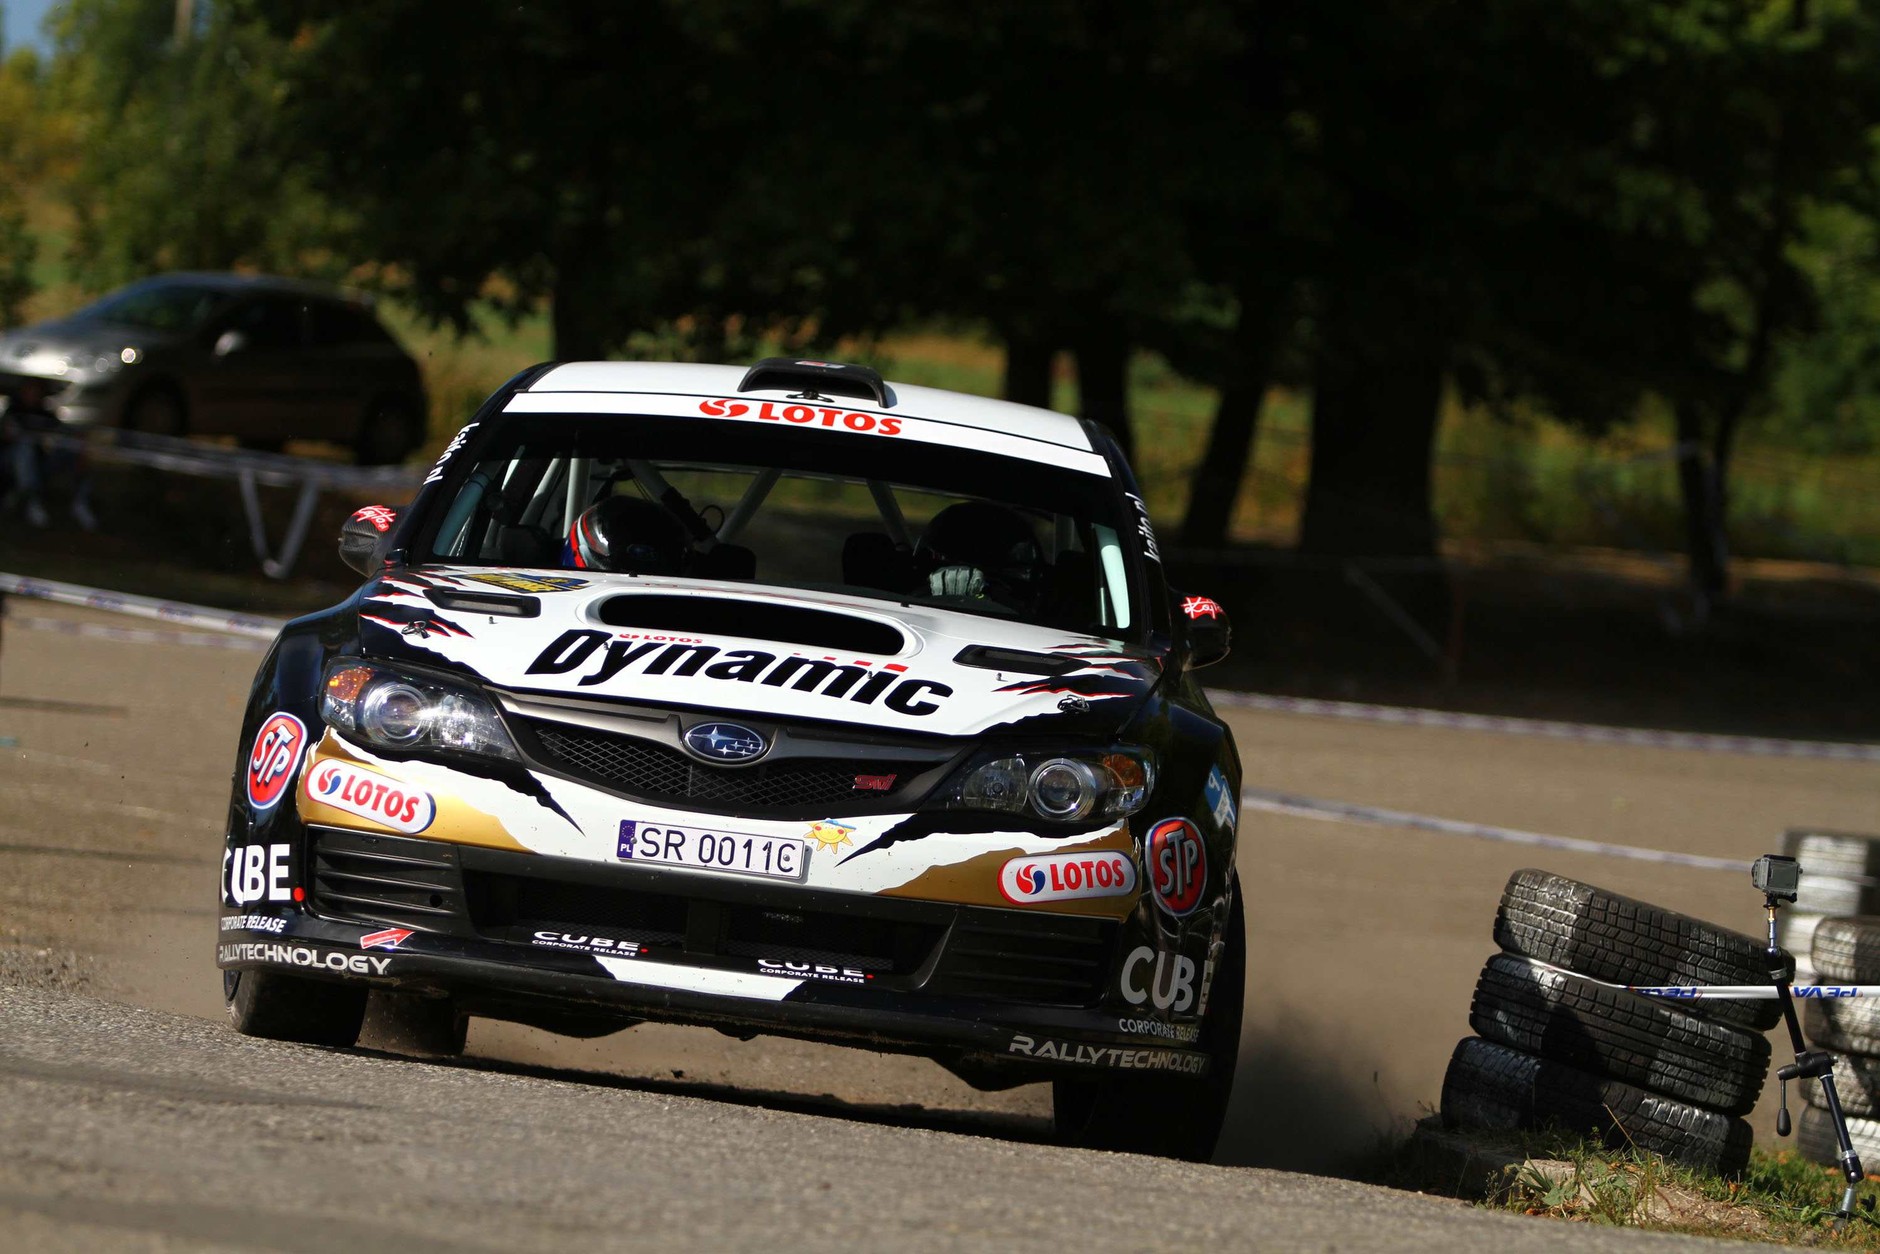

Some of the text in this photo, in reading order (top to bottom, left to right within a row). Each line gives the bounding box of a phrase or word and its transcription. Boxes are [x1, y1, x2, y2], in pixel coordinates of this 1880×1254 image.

[758, 402, 902, 436] LOTOS
[643, 633, 704, 645] LOTOS
[523, 628, 955, 717] Dynamic
[252, 723, 297, 787] STP
[340, 774, 420, 824] LOTOS
[619, 843, 632, 854] PL
[639, 826, 797, 873] SR 0011C
[1159, 827, 1200, 899] STP
[1049, 858, 1125, 892] LOTOS
[246, 915, 288, 933] RELEASE
[218, 943, 392, 976] RALLYTECHNOLOGY
[531, 939, 636, 958] CORPORATE RELEASE
[759, 967, 865, 984] CORPORATE RELEASE
[1118, 1017, 1200, 1043] CORPORATE RELEASE
[1008, 1034, 1206, 1075] RALLYTECHNOLOGY
